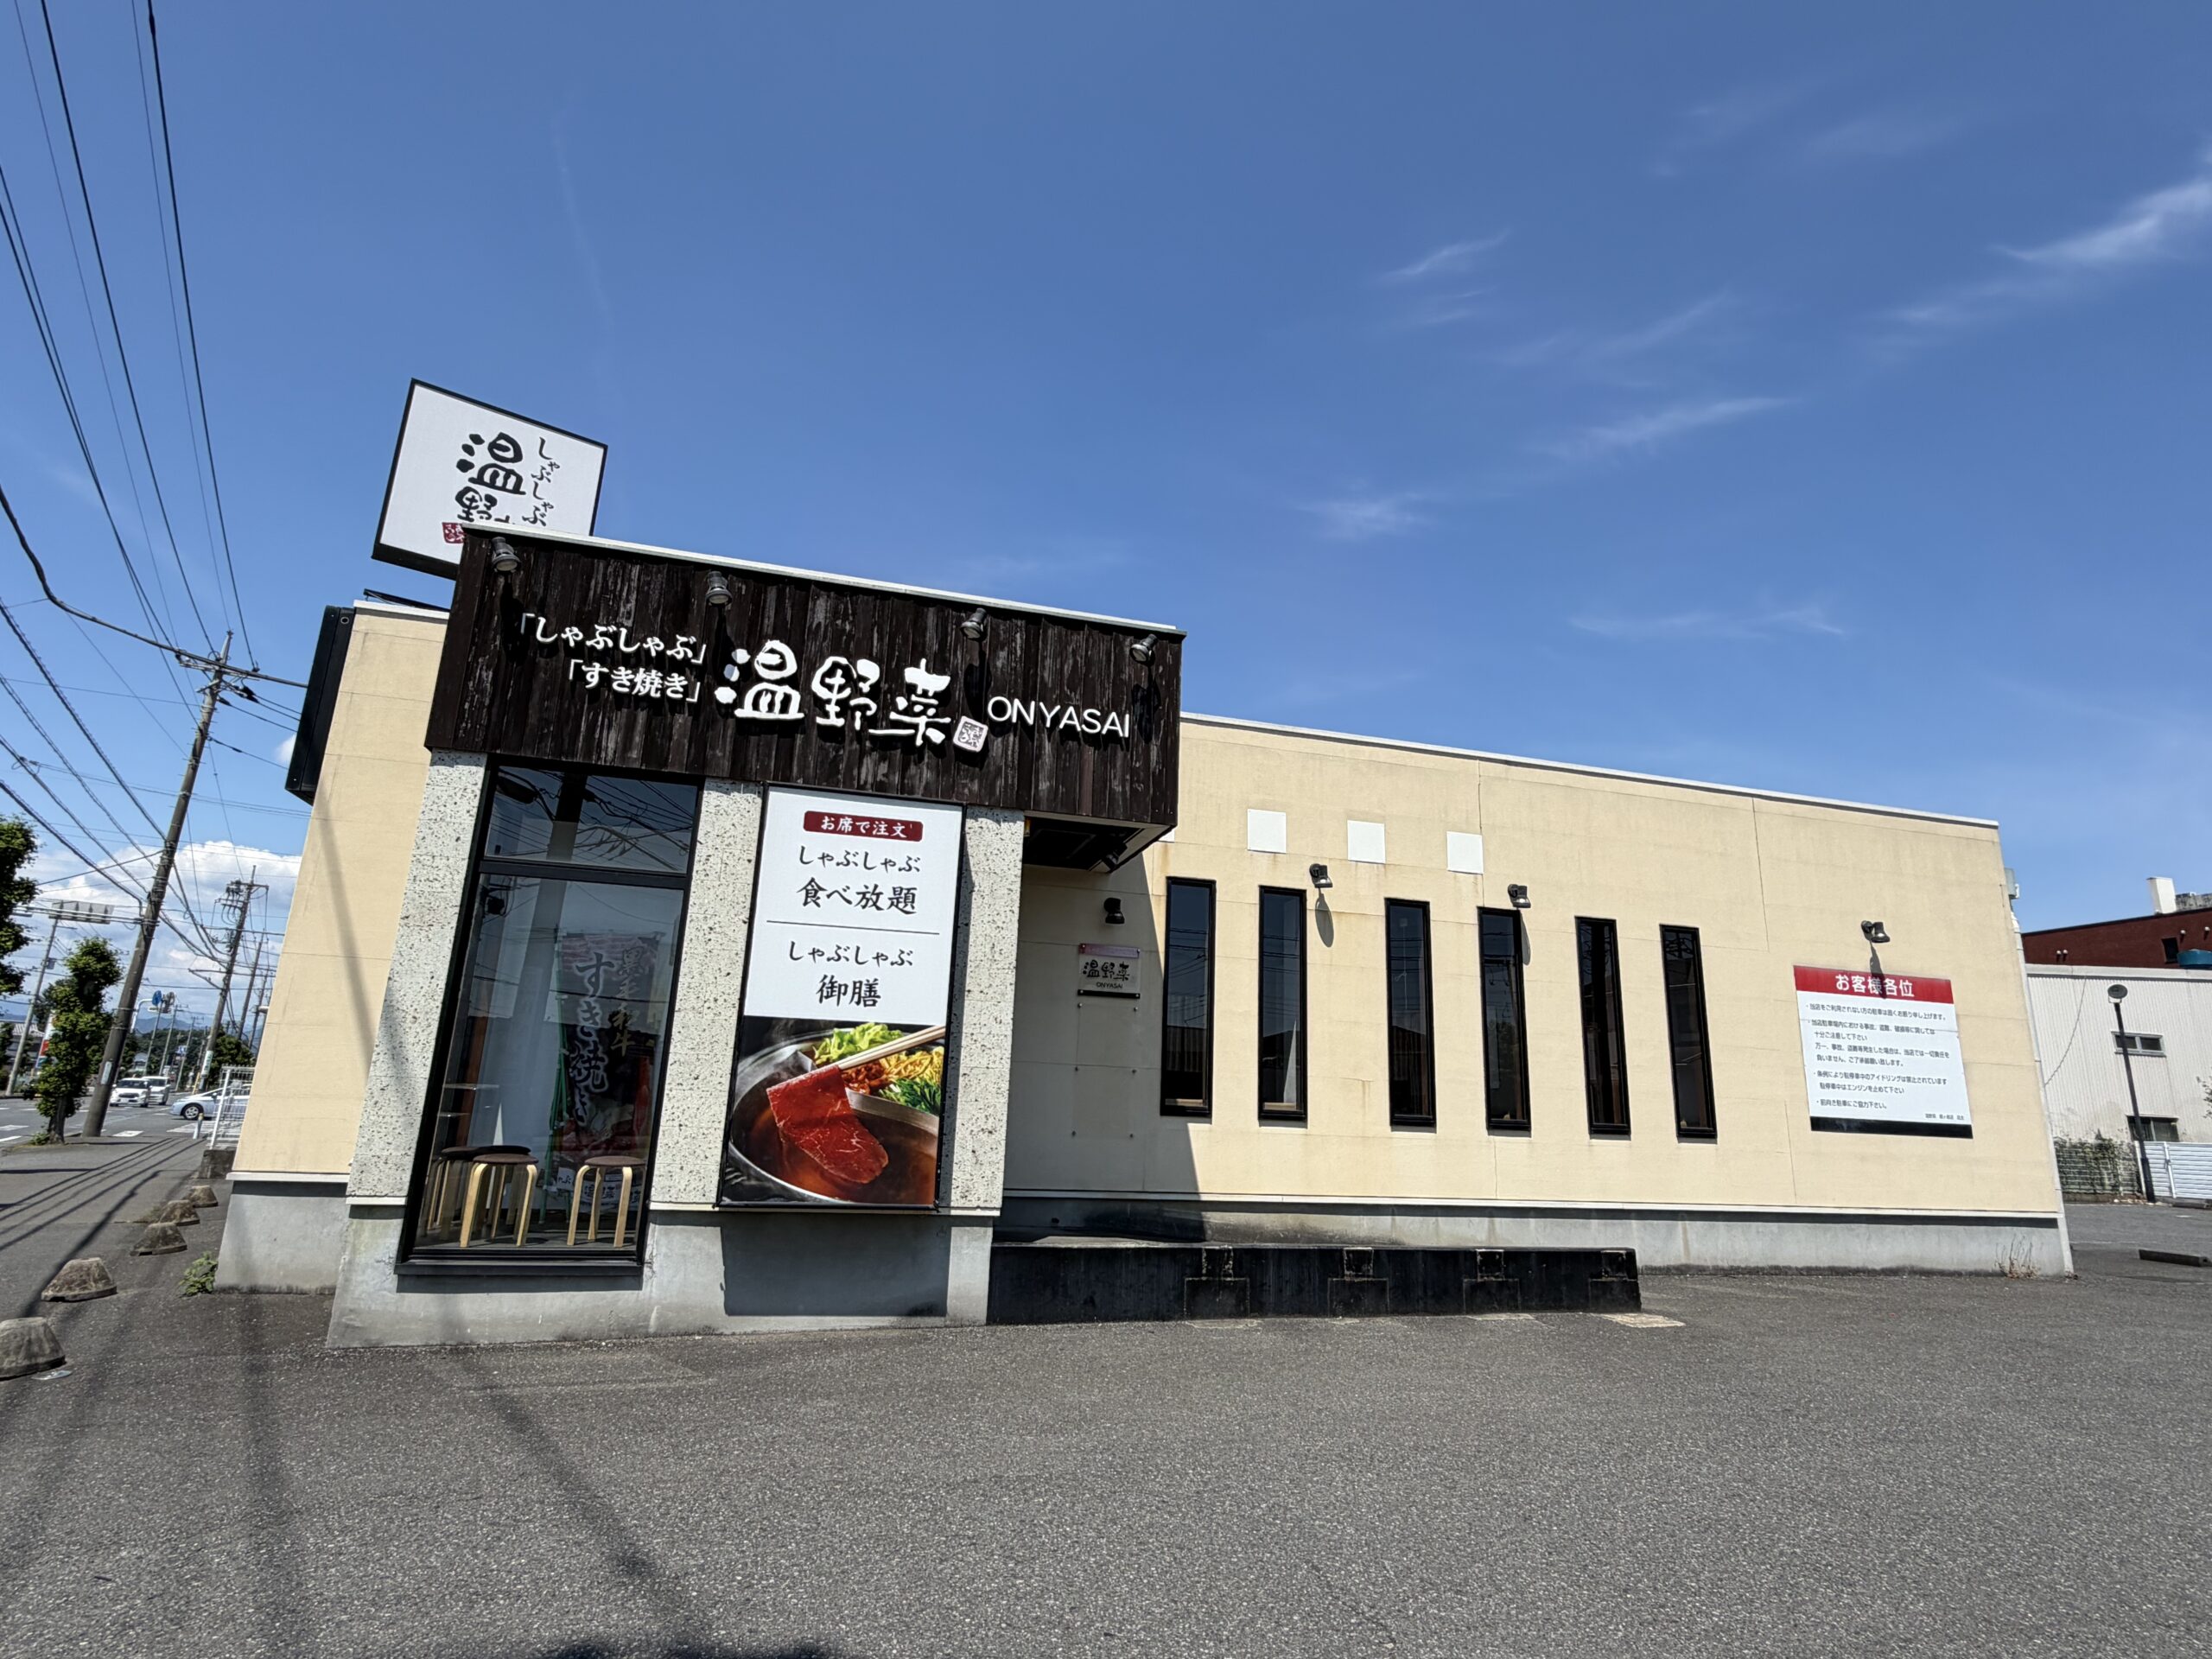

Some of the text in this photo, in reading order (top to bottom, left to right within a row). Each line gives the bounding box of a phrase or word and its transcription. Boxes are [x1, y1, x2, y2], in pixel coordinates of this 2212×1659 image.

[455, 432, 526, 524] 温野
[522, 436, 560, 526] しゃぶしゃぶ
[715, 639, 950, 746] 温野菜
[988, 696, 1129, 738] ONYASAI
[821, 816, 906, 838] お席で注文
[799, 845, 921, 873] しゃぶしゃぶ
[797, 877, 918, 914] 食べ放題
[789, 941, 913, 967] しゃぶしゃぶ
[1083, 959, 1130, 982] 温野菜
[817, 974, 881, 1007] 御膳
[1835, 974, 1915, 997] お客様各位
